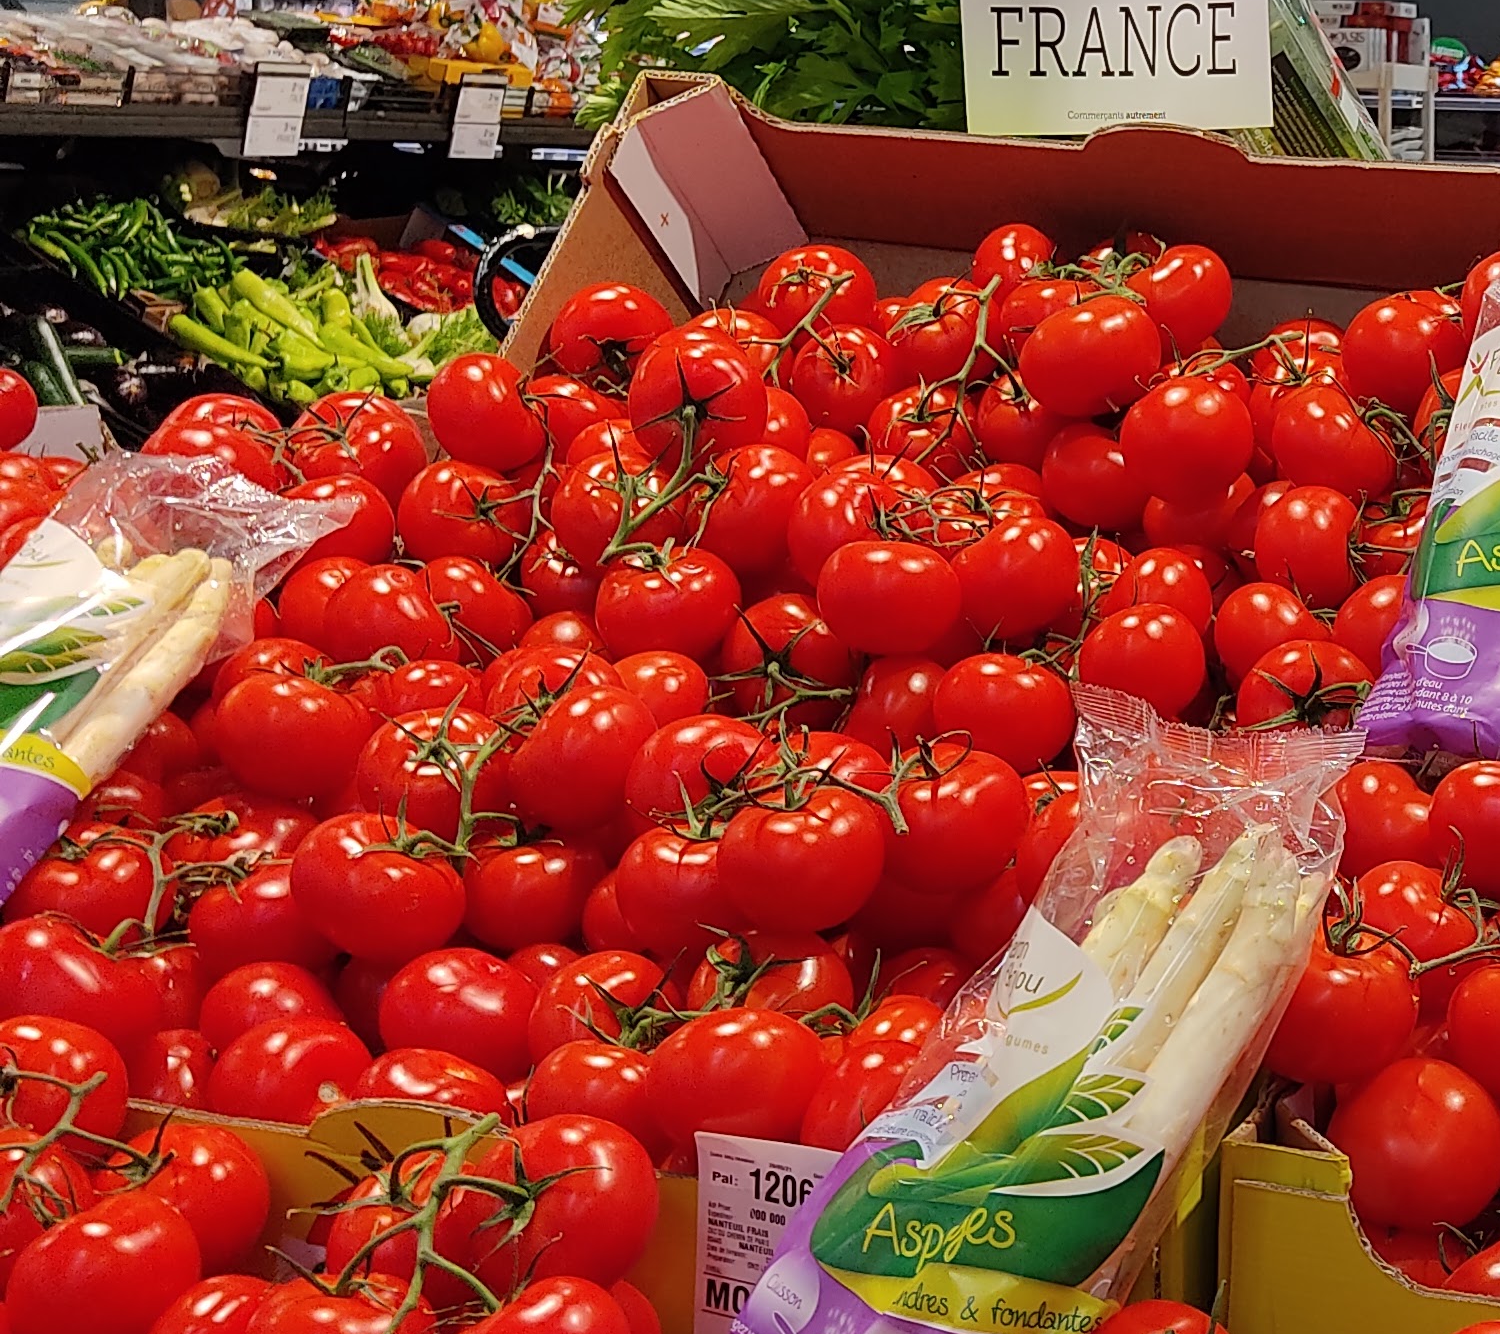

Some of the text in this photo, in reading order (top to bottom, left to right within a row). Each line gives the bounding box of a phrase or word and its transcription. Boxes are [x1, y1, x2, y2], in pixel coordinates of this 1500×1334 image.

[989, 1, 1237, 79] FRANCE
[1067, 110, 1167, 121] Commerçants autrement
[1416, 699, 1442, 712] nutes
[1441, 692, 1449, 701] 8
[1460, 695, 1473, 705] 10
[2, 748, 55, 771] antes
[1005, 1034, 1049, 1056] gumes
[708, 1217, 769, 1238] NANTEUIL FRAIS
[959, 1295, 980, 1323] &
